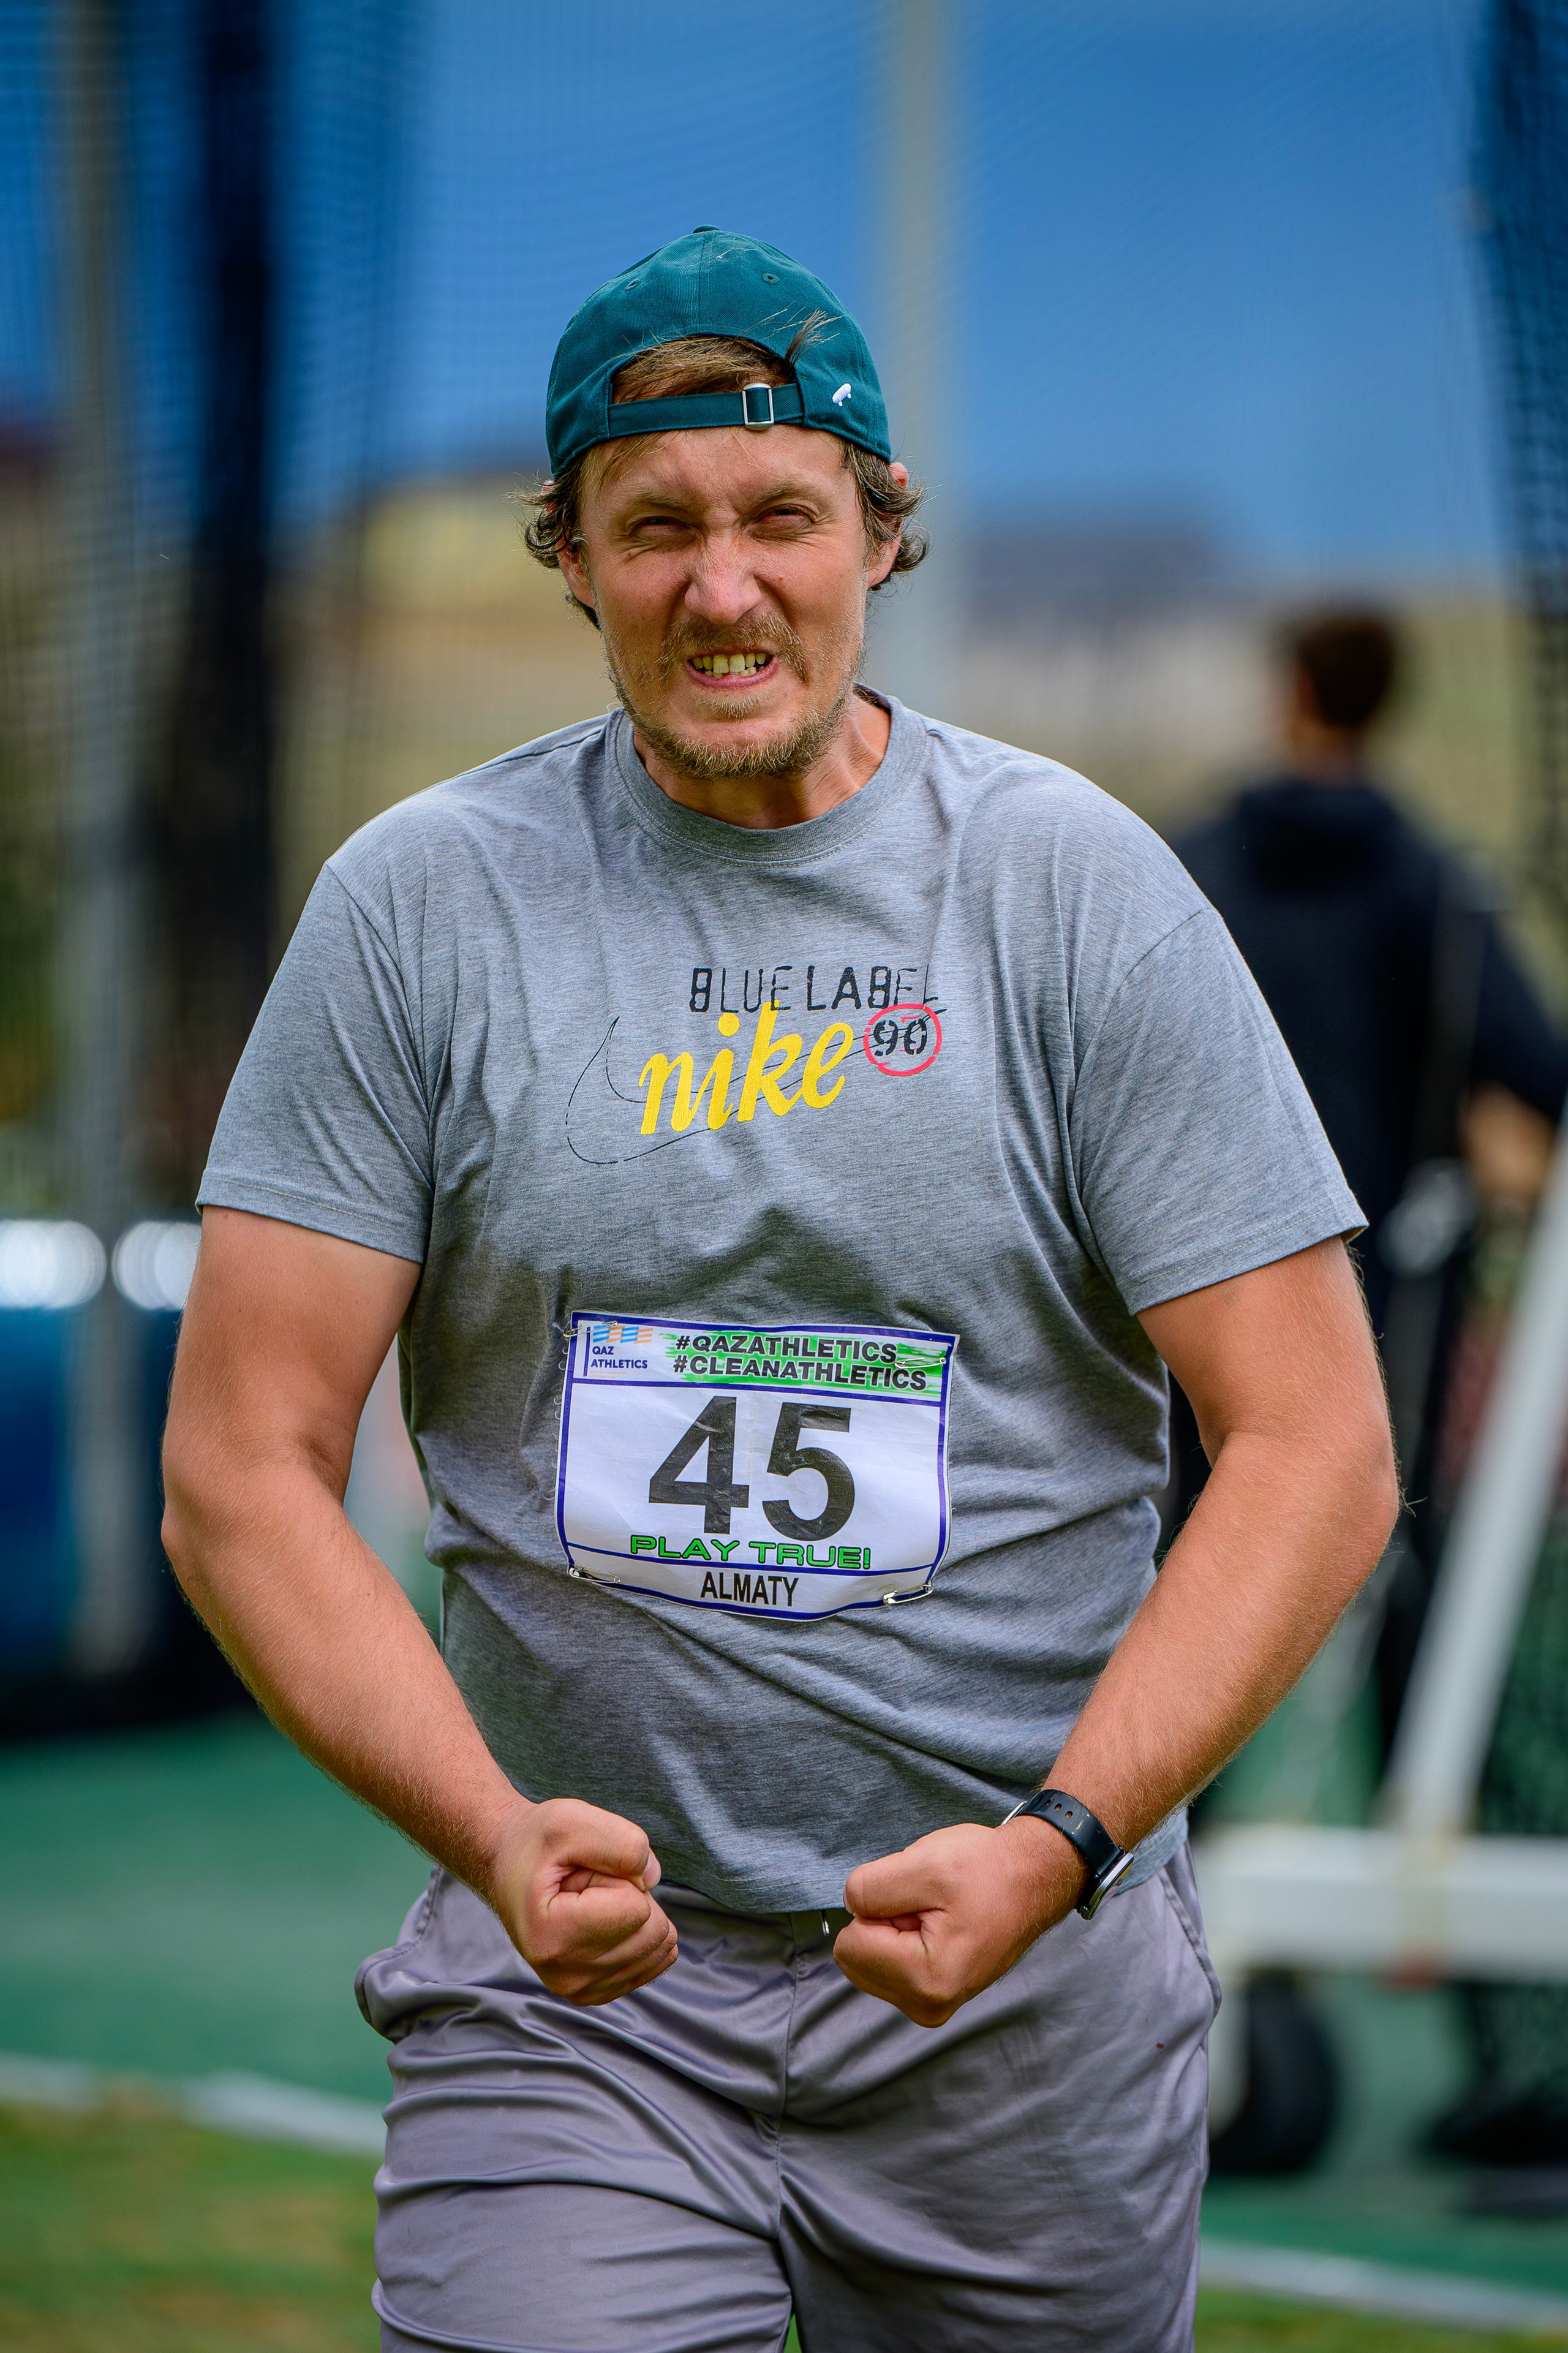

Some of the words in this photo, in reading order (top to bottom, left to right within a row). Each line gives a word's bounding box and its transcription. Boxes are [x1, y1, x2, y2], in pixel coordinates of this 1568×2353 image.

[690, 965, 793, 1013] BLUE
[806, 964, 938, 1011] LABEL
[872, 1019, 928, 1056] 90
[638, 999, 854, 1135] nike
[590, 1359, 648, 1369] ATHLETICS
[592, 1345, 614, 1355] QAZ
[676, 1334, 897, 1364] #QAZATHLETICS
[673, 1354, 927, 1391] #CLEANATHLETICS
[648, 1396, 856, 1542] 45
[630, 1535, 740, 1562] PLAY
[748, 1541, 871, 1570] TRUE!
[700, 1571, 799, 1607] ALMATY
